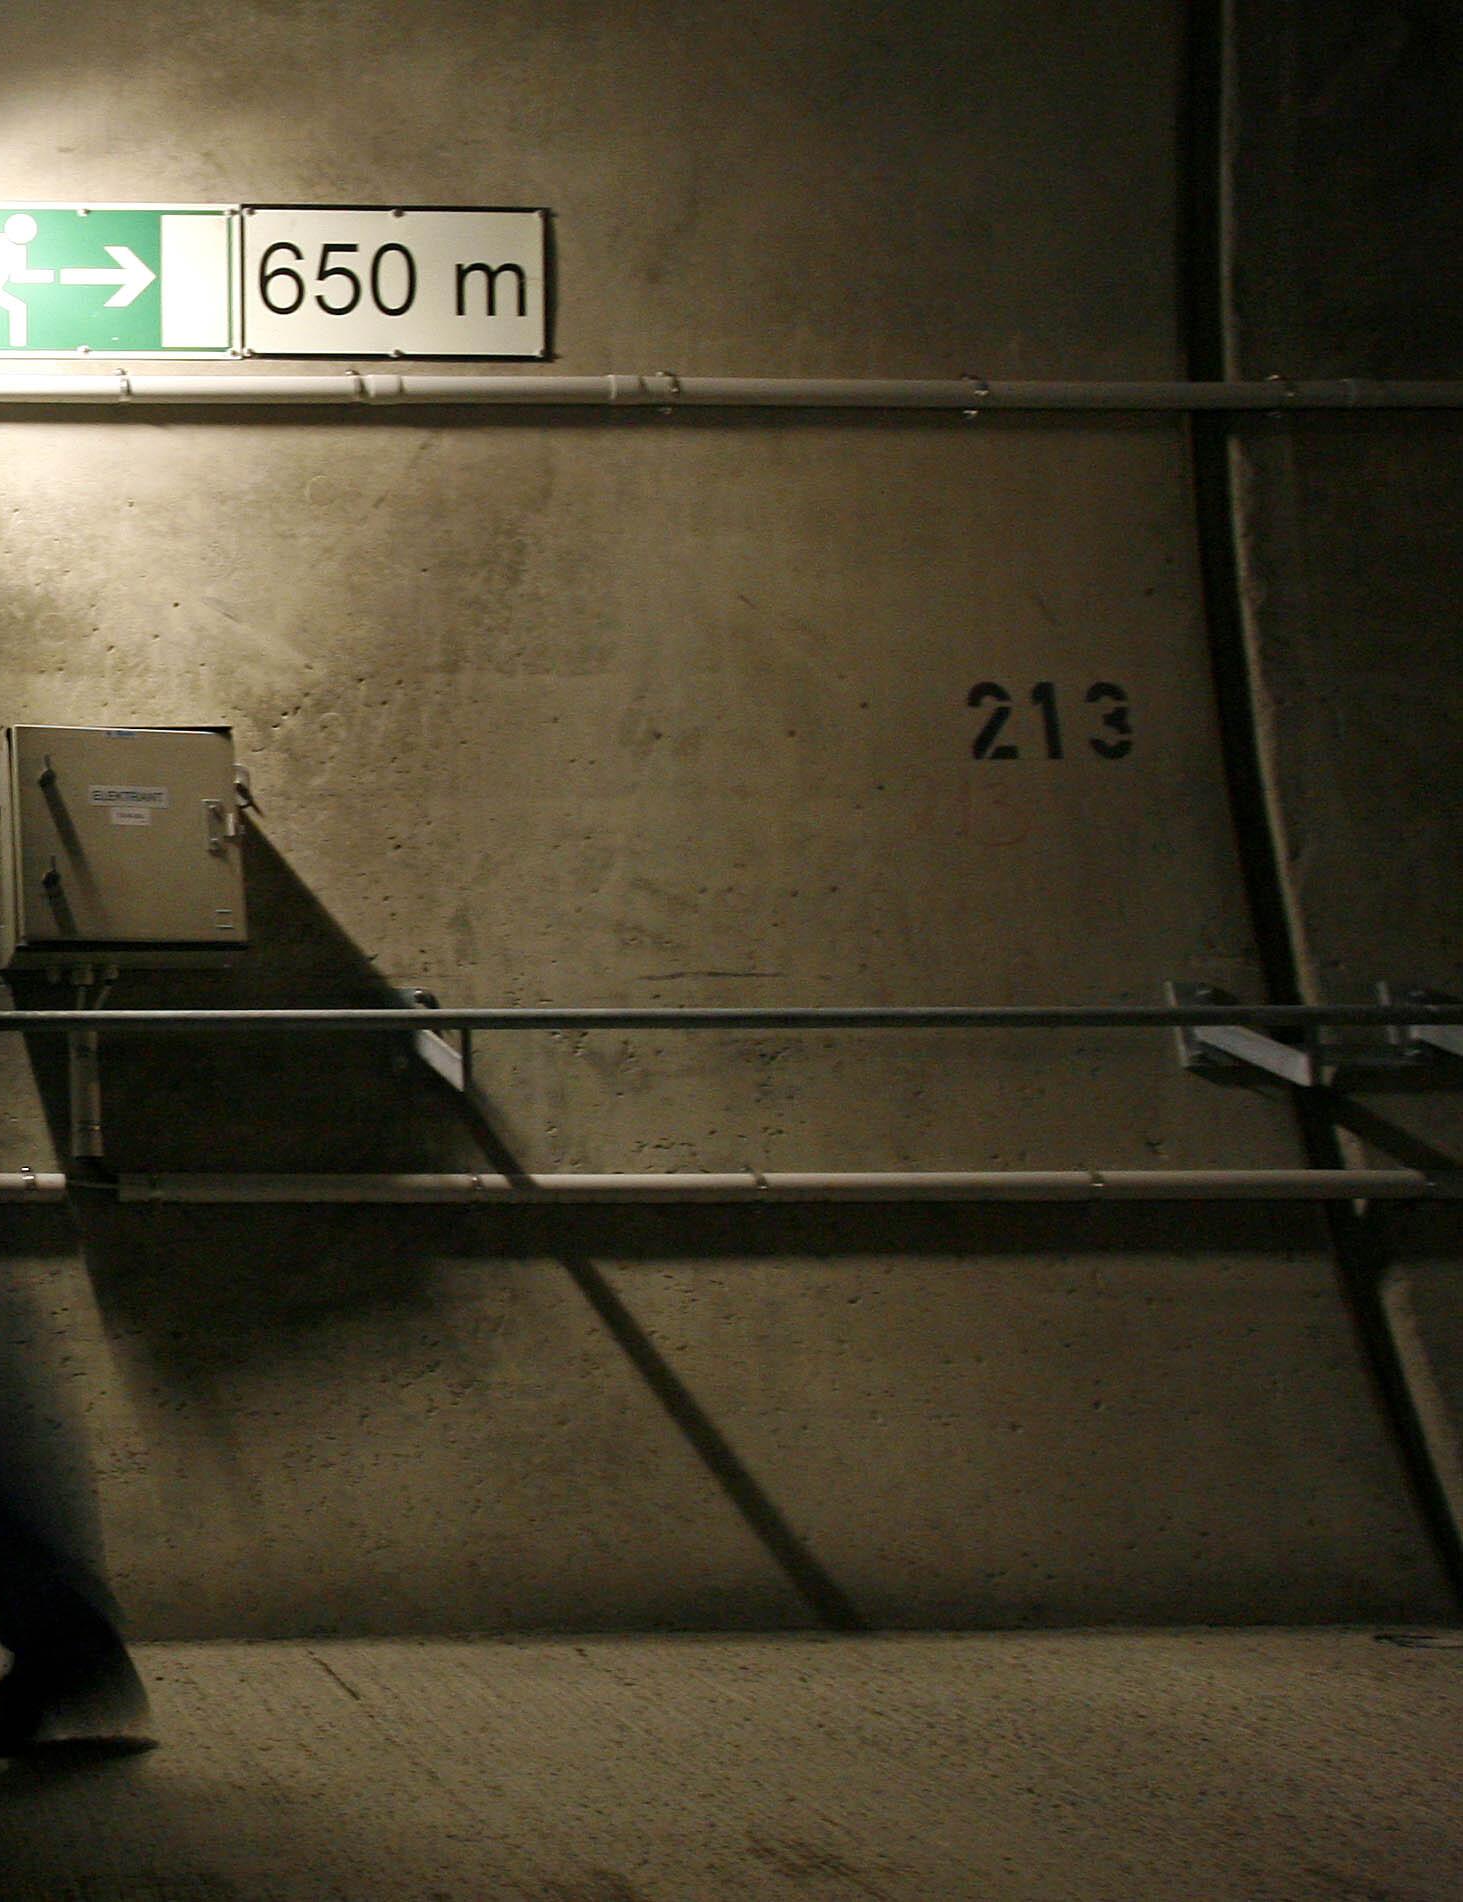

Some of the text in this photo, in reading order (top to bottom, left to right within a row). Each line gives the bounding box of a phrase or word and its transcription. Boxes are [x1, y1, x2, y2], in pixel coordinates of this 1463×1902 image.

[259, 241, 527, 317] 650 m
[966, 681, 1133, 760] 213
